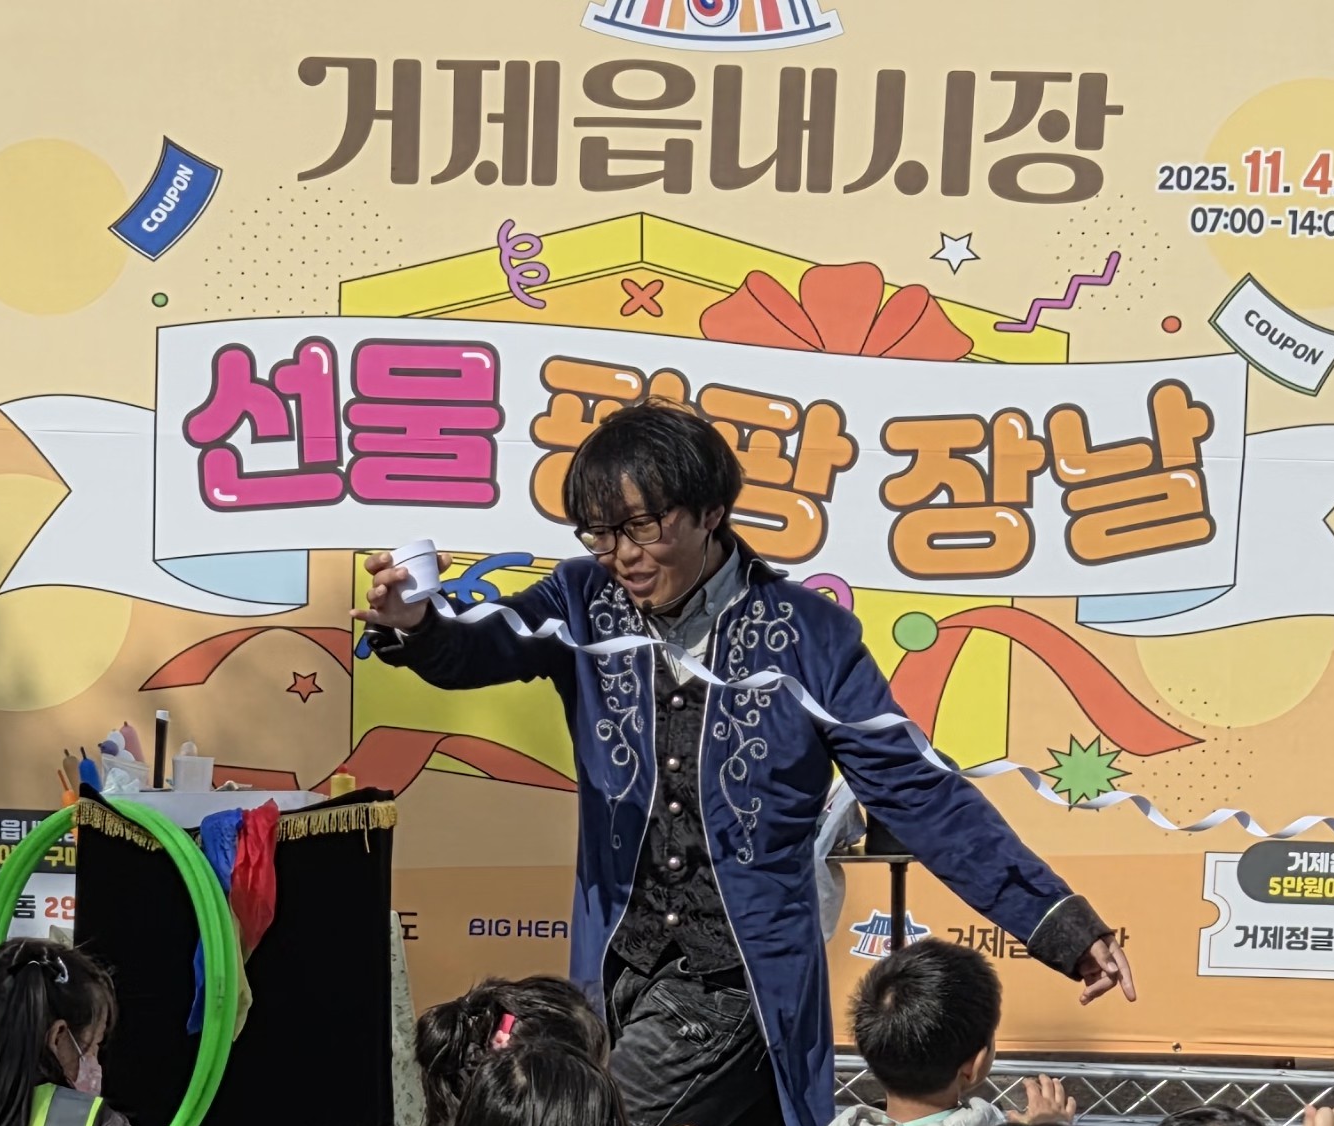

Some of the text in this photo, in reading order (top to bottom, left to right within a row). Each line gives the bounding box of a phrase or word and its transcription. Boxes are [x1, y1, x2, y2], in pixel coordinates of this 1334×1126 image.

[296, 55, 1124, 202] 거제읍내시장
[141, 163, 193, 232] COUPON
[1158, 165, 1235, 191] 2025.
[1244, 150, 1291, 193] 11.
[1190, 206, 1264, 234] 07:00
[1244, 308, 1324, 365] COUPON
[185, 337, 504, 512] 선물
[879, 377, 1217, 580] 장날
[469, 918, 511, 937] BIG
